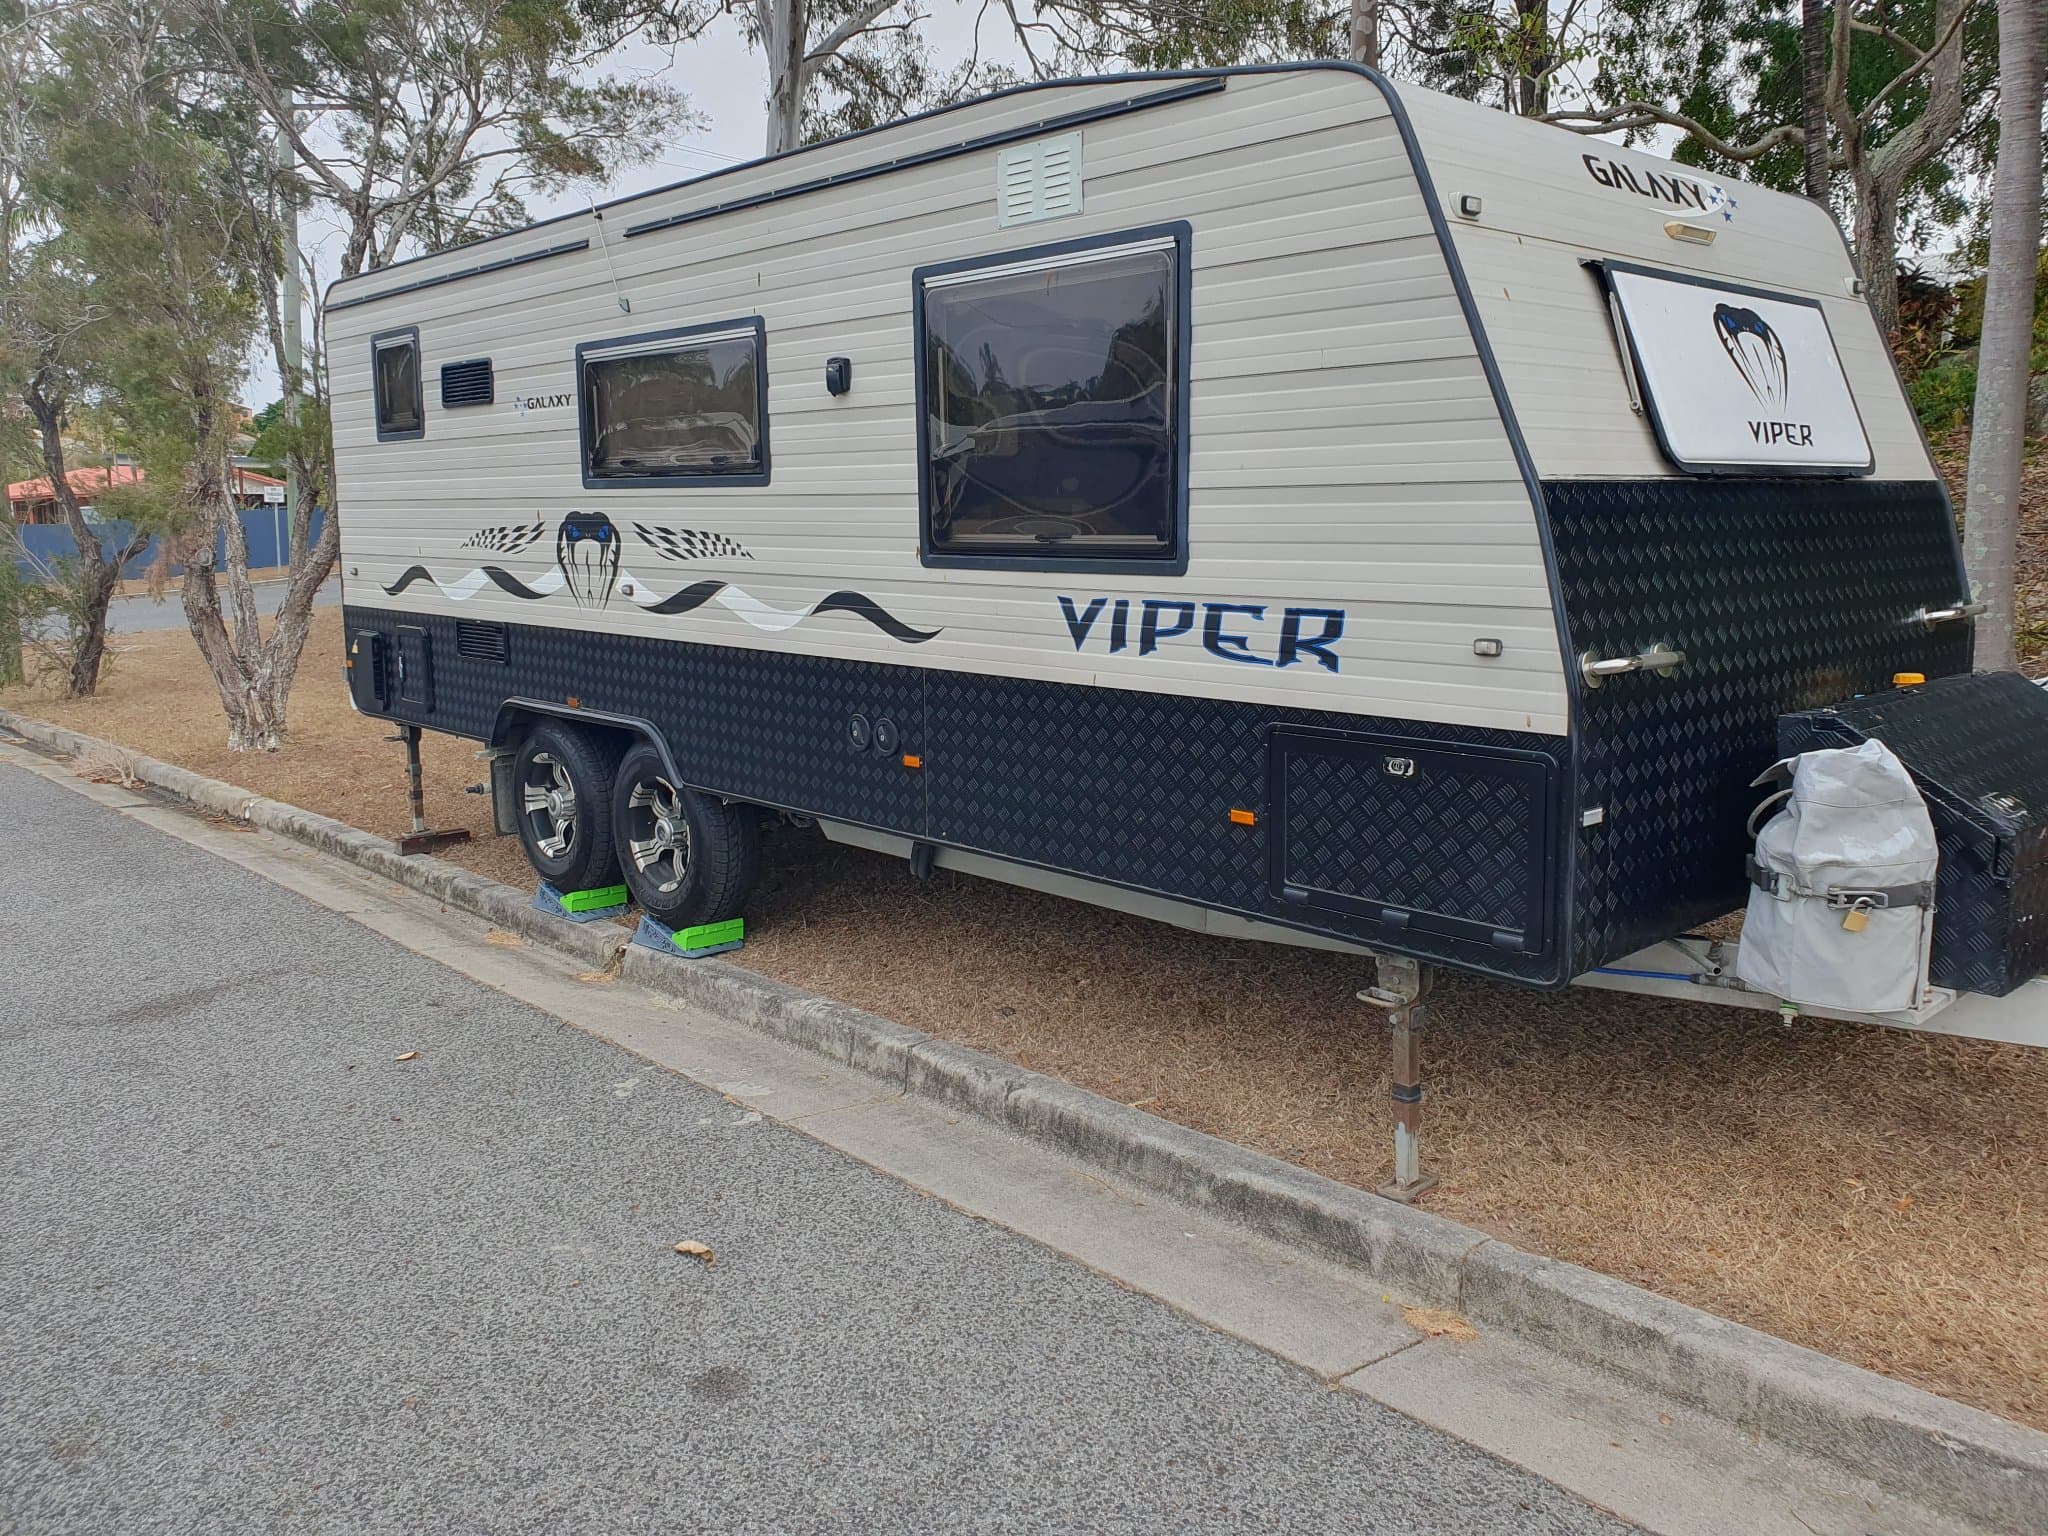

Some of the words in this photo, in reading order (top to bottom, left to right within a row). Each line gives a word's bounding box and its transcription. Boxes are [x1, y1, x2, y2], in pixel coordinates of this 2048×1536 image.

[1582, 153, 1708, 211] GALAXY
[527, 394, 572, 410] GALAXY
[1747, 420, 1814, 447] VIPER
[1057, 595, 1345, 673] VIPER
